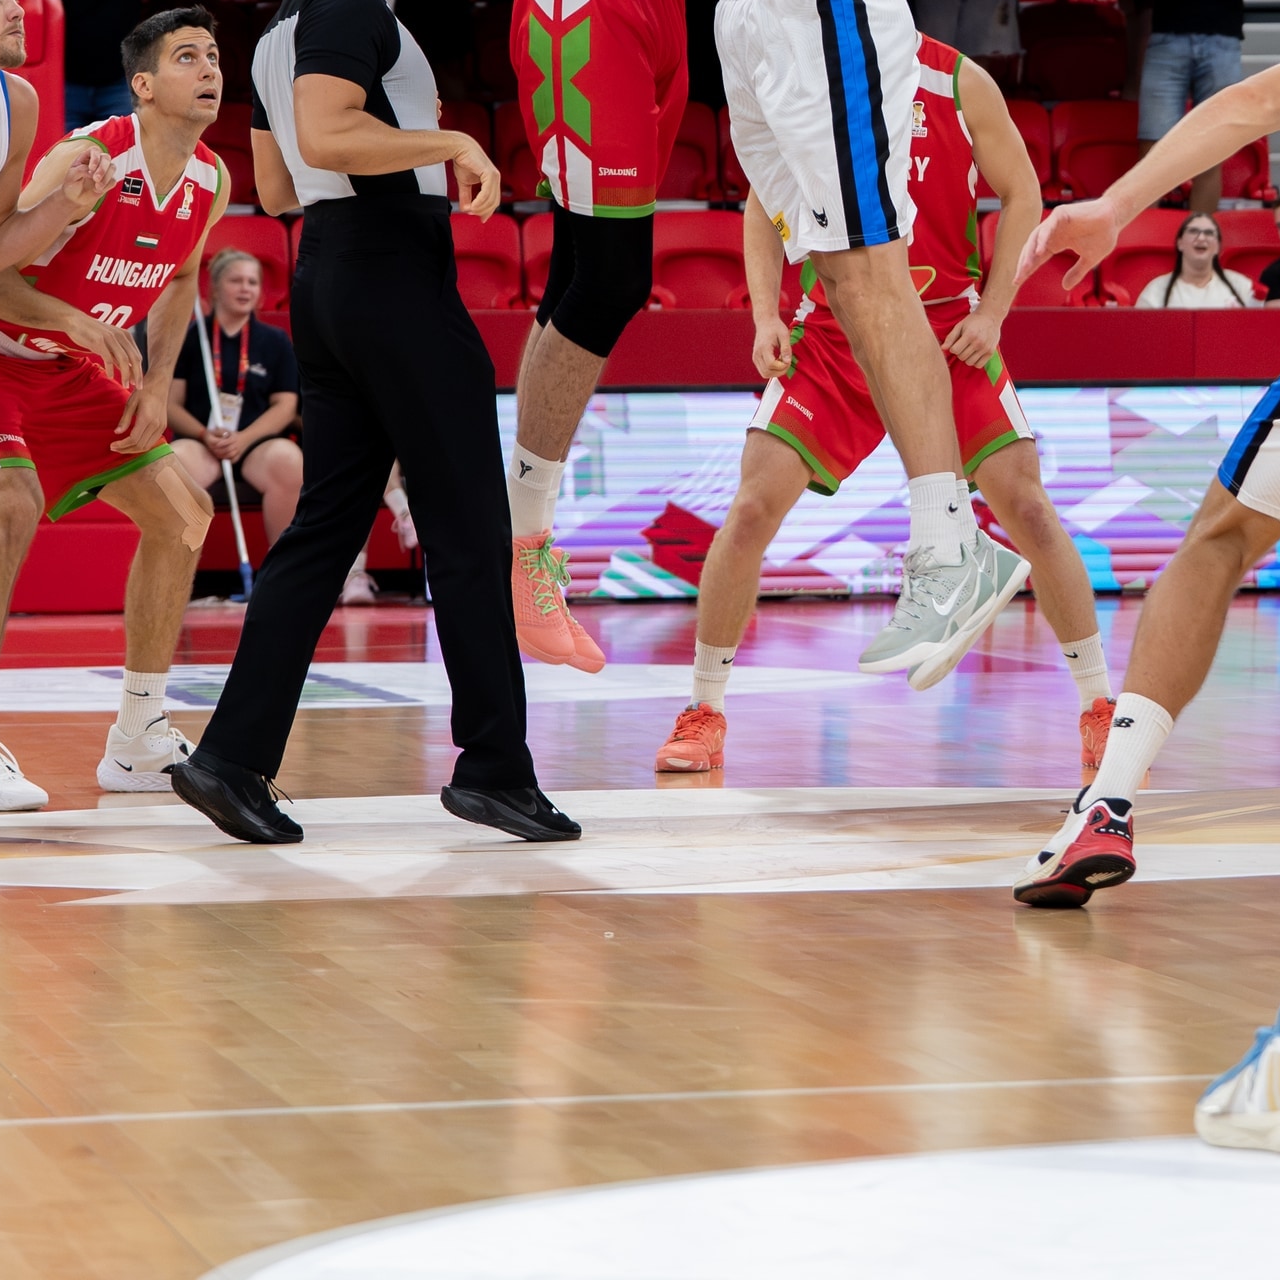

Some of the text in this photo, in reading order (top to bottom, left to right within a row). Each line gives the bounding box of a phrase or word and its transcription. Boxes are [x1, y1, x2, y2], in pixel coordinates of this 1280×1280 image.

[598, 166, 637, 177] SPALDING
[86, 254, 176, 289] HUNGARY
[786, 395, 814, 421] SPALDING
